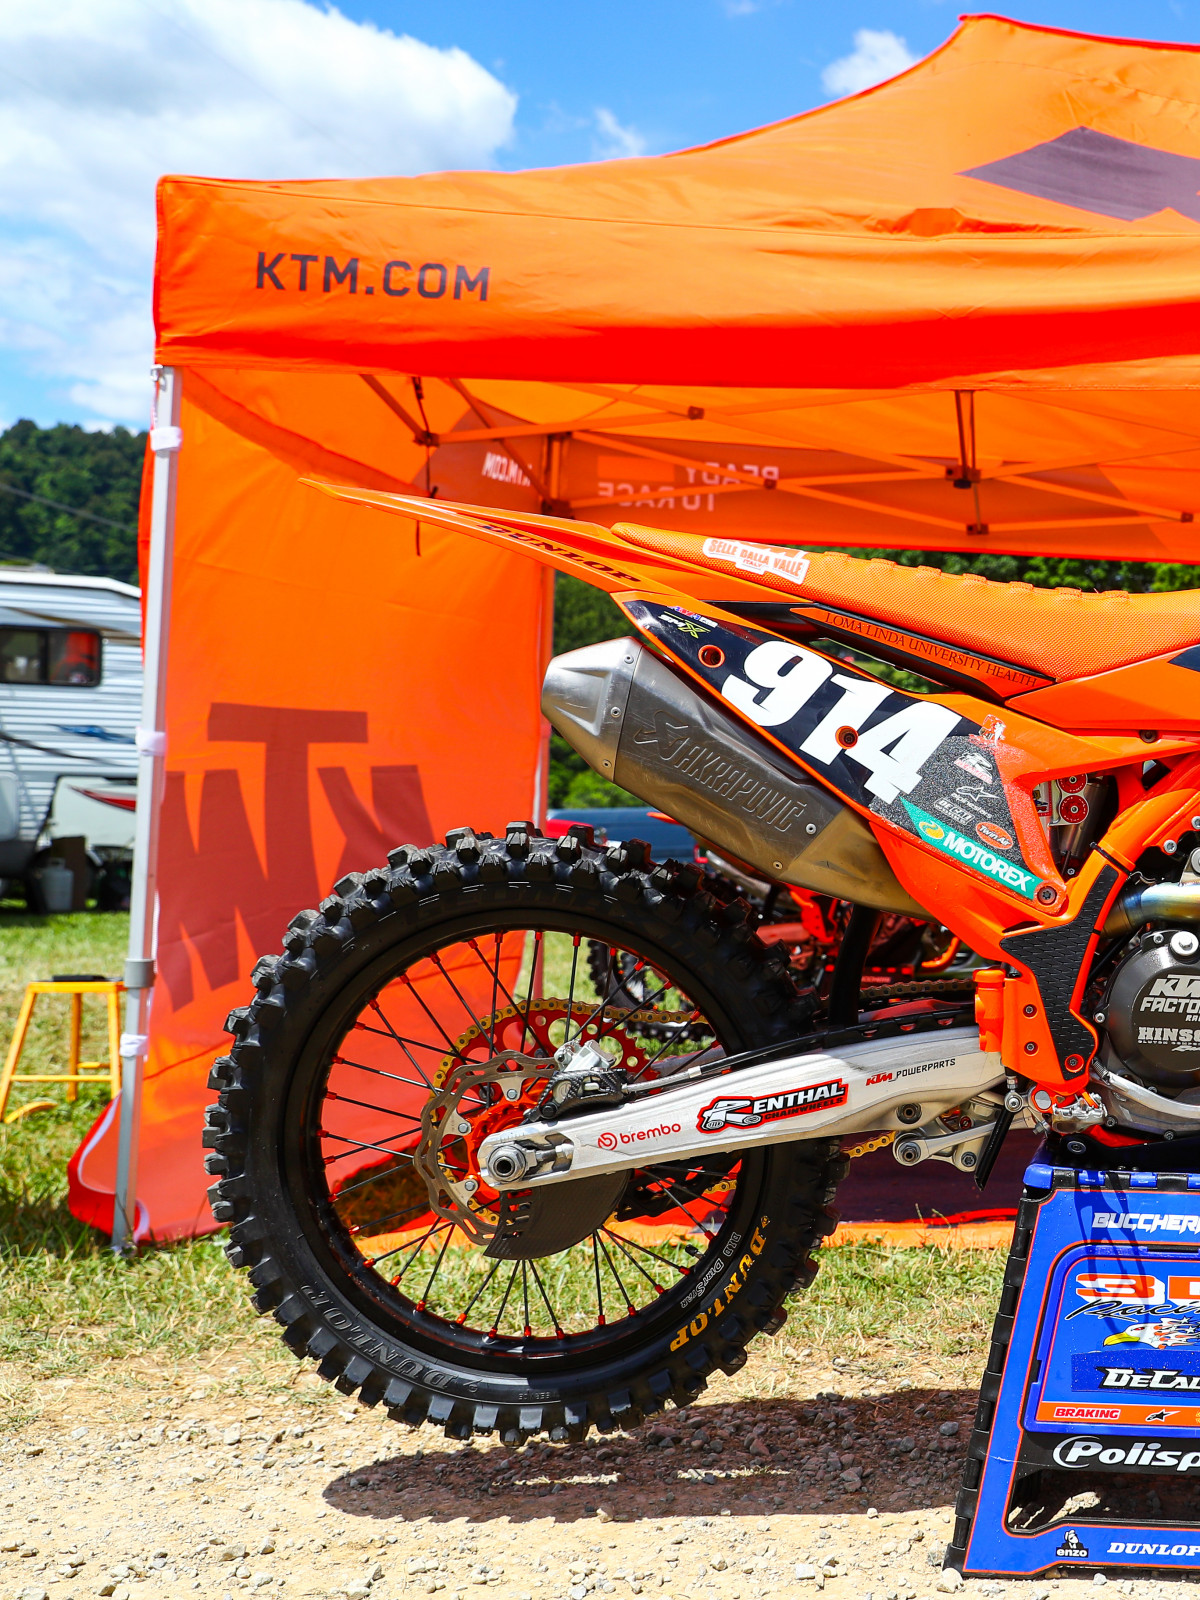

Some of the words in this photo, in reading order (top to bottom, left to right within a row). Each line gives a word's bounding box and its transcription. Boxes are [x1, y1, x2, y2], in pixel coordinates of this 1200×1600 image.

[256, 251, 490, 301] KTM.COM
[477, 523, 642, 583] DUNLOP
[708, 539, 737, 560] SELLE
[739, 548, 769, 568] DALLA
[773, 553, 804, 578] VALLE
[743, 558, 763, 570] ITALY
[825, 613, 862, 633] LOMA
[866, 625, 905, 648] LINDA
[908, 635, 983, 671] UNIVERSITY
[985, 664, 1037, 687] HEALTH
[721, 640, 962, 806] 914
[979, 825, 997, 840] Twin
[997, 835, 1012, 846] Air
[943, 832, 1032, 892] MOTOREX
[865, 1072, 893, 1087] KTM
[897, 1058, 956, 1080] POWERPARTS
[764, 1097, 843, 1120] CHAINWHEELS
[620, 1122, 682, 1145] brembo
[670, 1227, 767, 1352] DUNLOP
[1054, 1408, 1121, 1419] BRAKING
[1057, 1548, 1088, 1558] enzo
